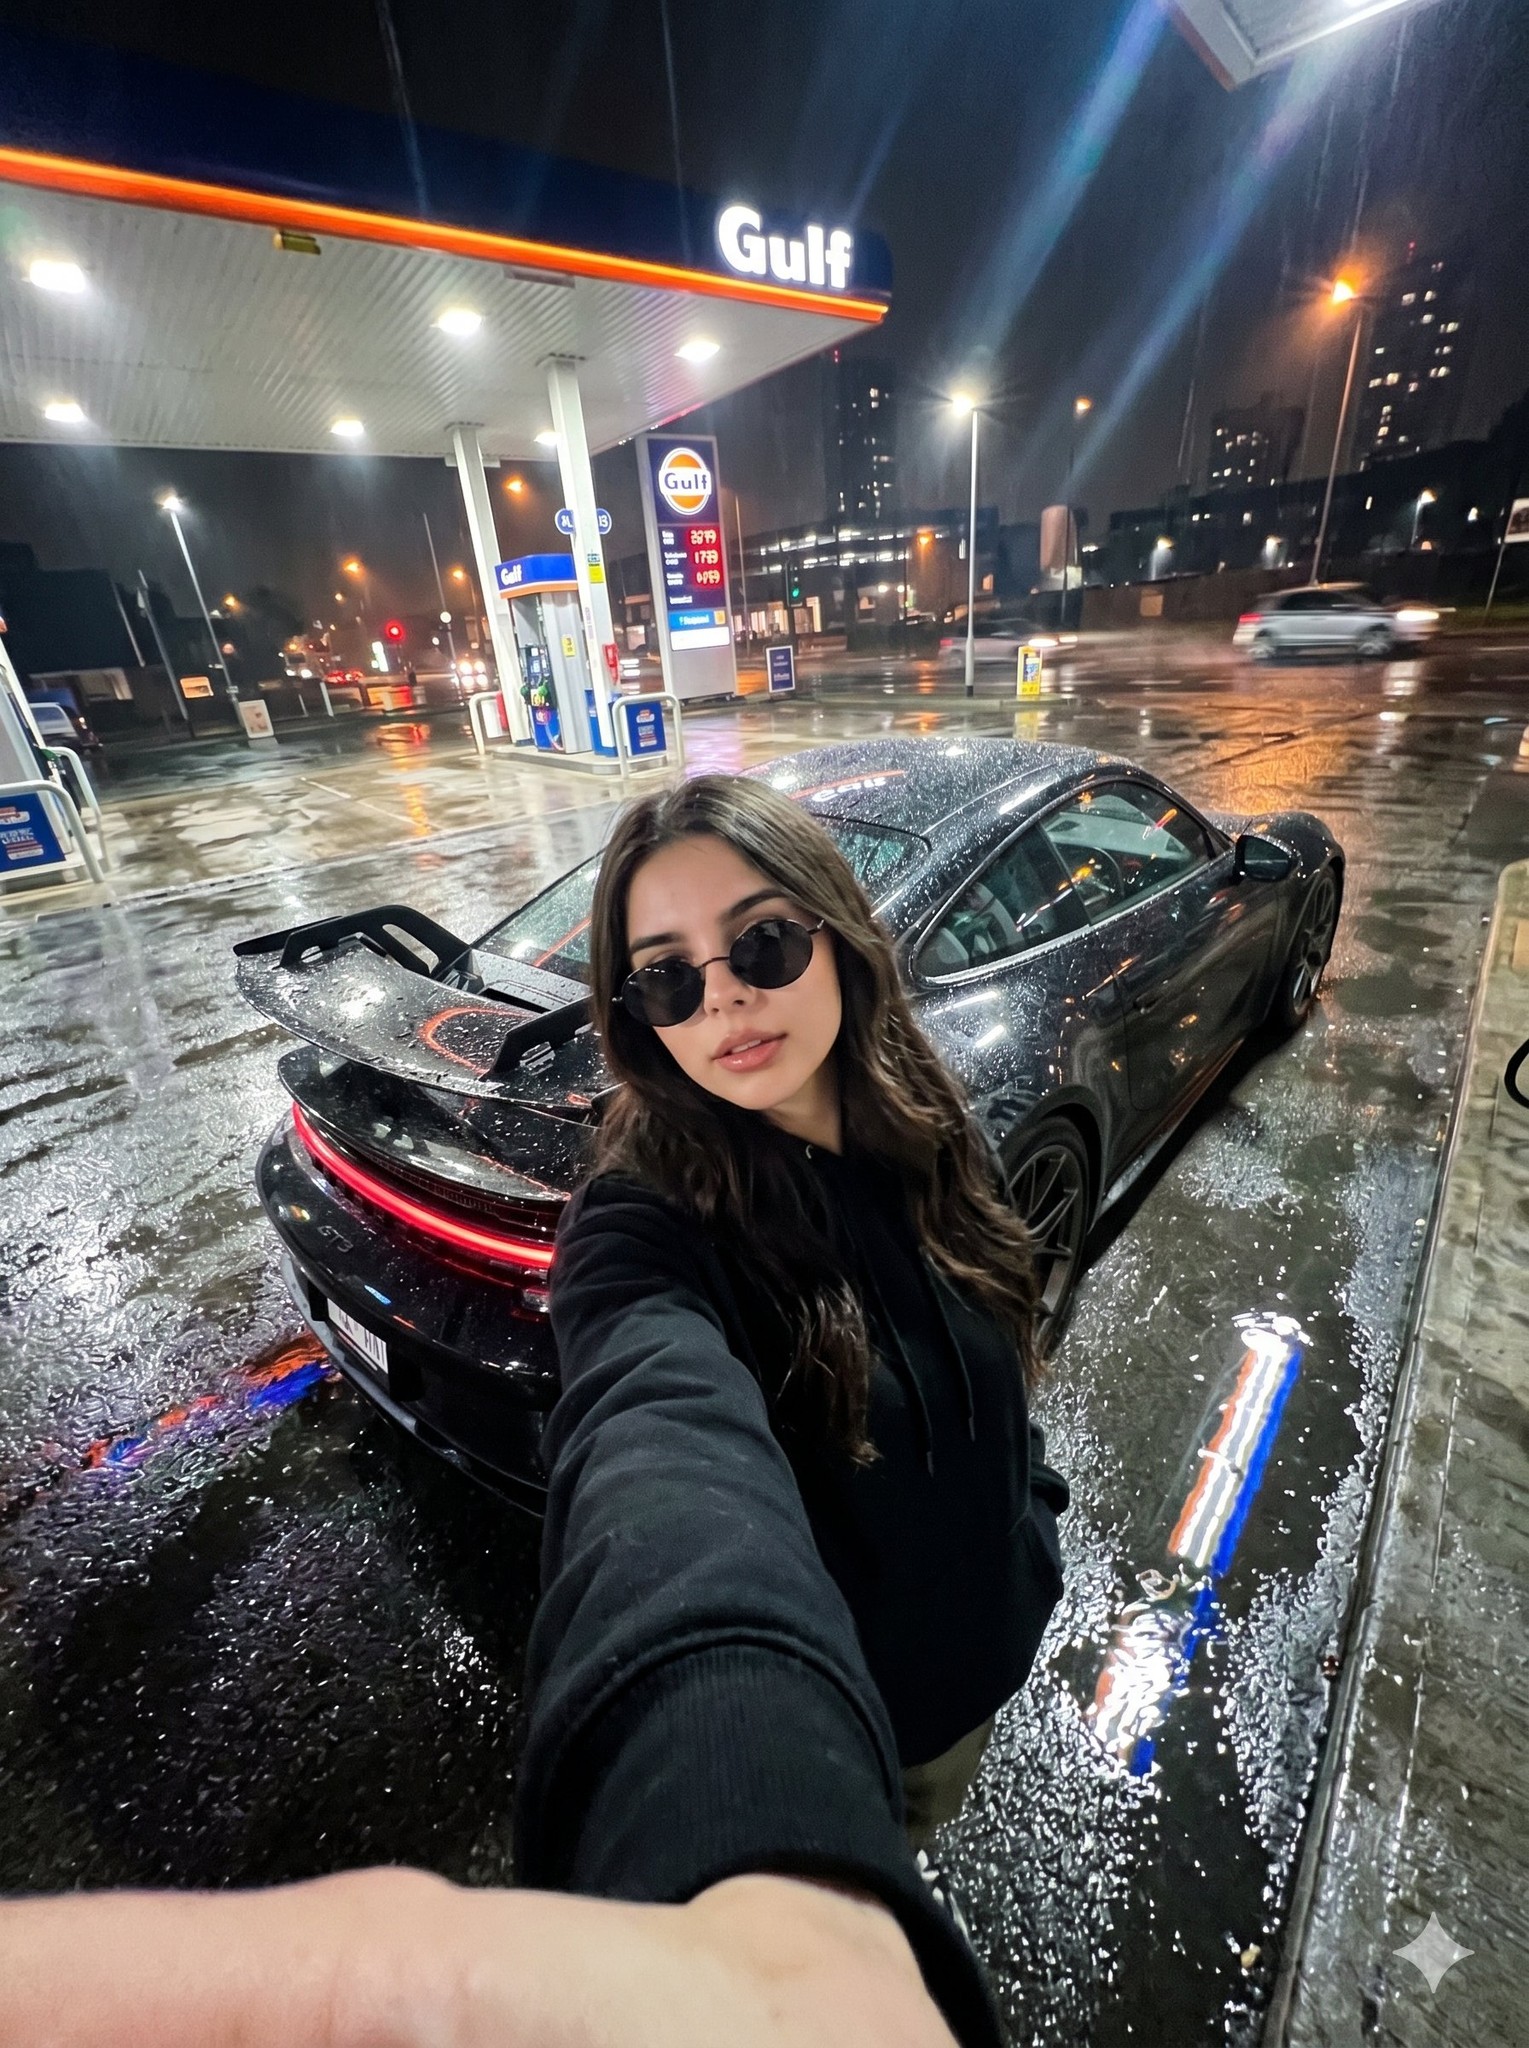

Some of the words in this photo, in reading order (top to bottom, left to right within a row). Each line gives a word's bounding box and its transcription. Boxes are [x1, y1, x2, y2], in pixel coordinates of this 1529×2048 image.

[718, 206, 851, 289] Gulf
[664, 472, 707, 489] Gulf
[500, 564, 523, 586] Gulf
[317, 1225, 354, 1253] GT3
